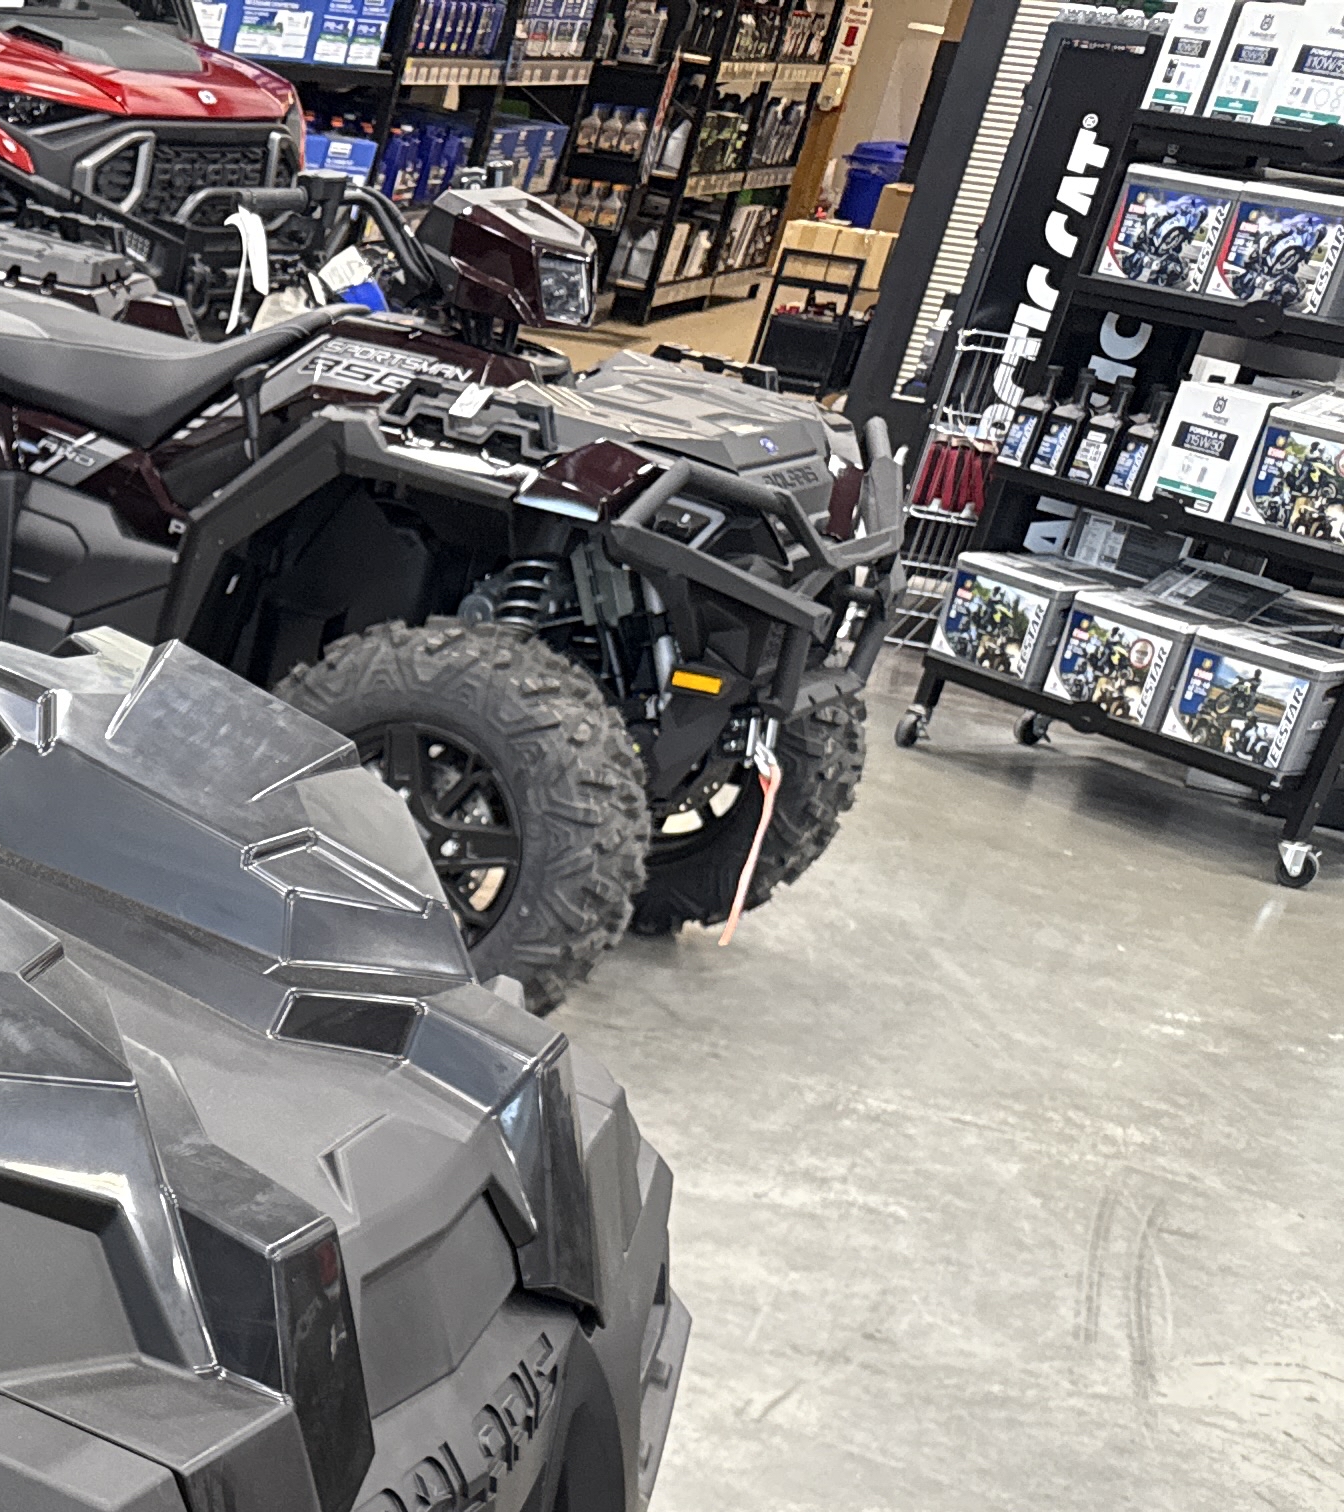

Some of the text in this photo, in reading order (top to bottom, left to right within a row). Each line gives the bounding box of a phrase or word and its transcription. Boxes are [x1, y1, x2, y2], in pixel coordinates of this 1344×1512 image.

[325, 340, 474, 382] SPORTSMAN
[1016, 603, 1046, 679] ECSTAR
[1136, 645, 1168, 721] ECSTAR
[1269, 686, 1305, 764] ECSTAR
